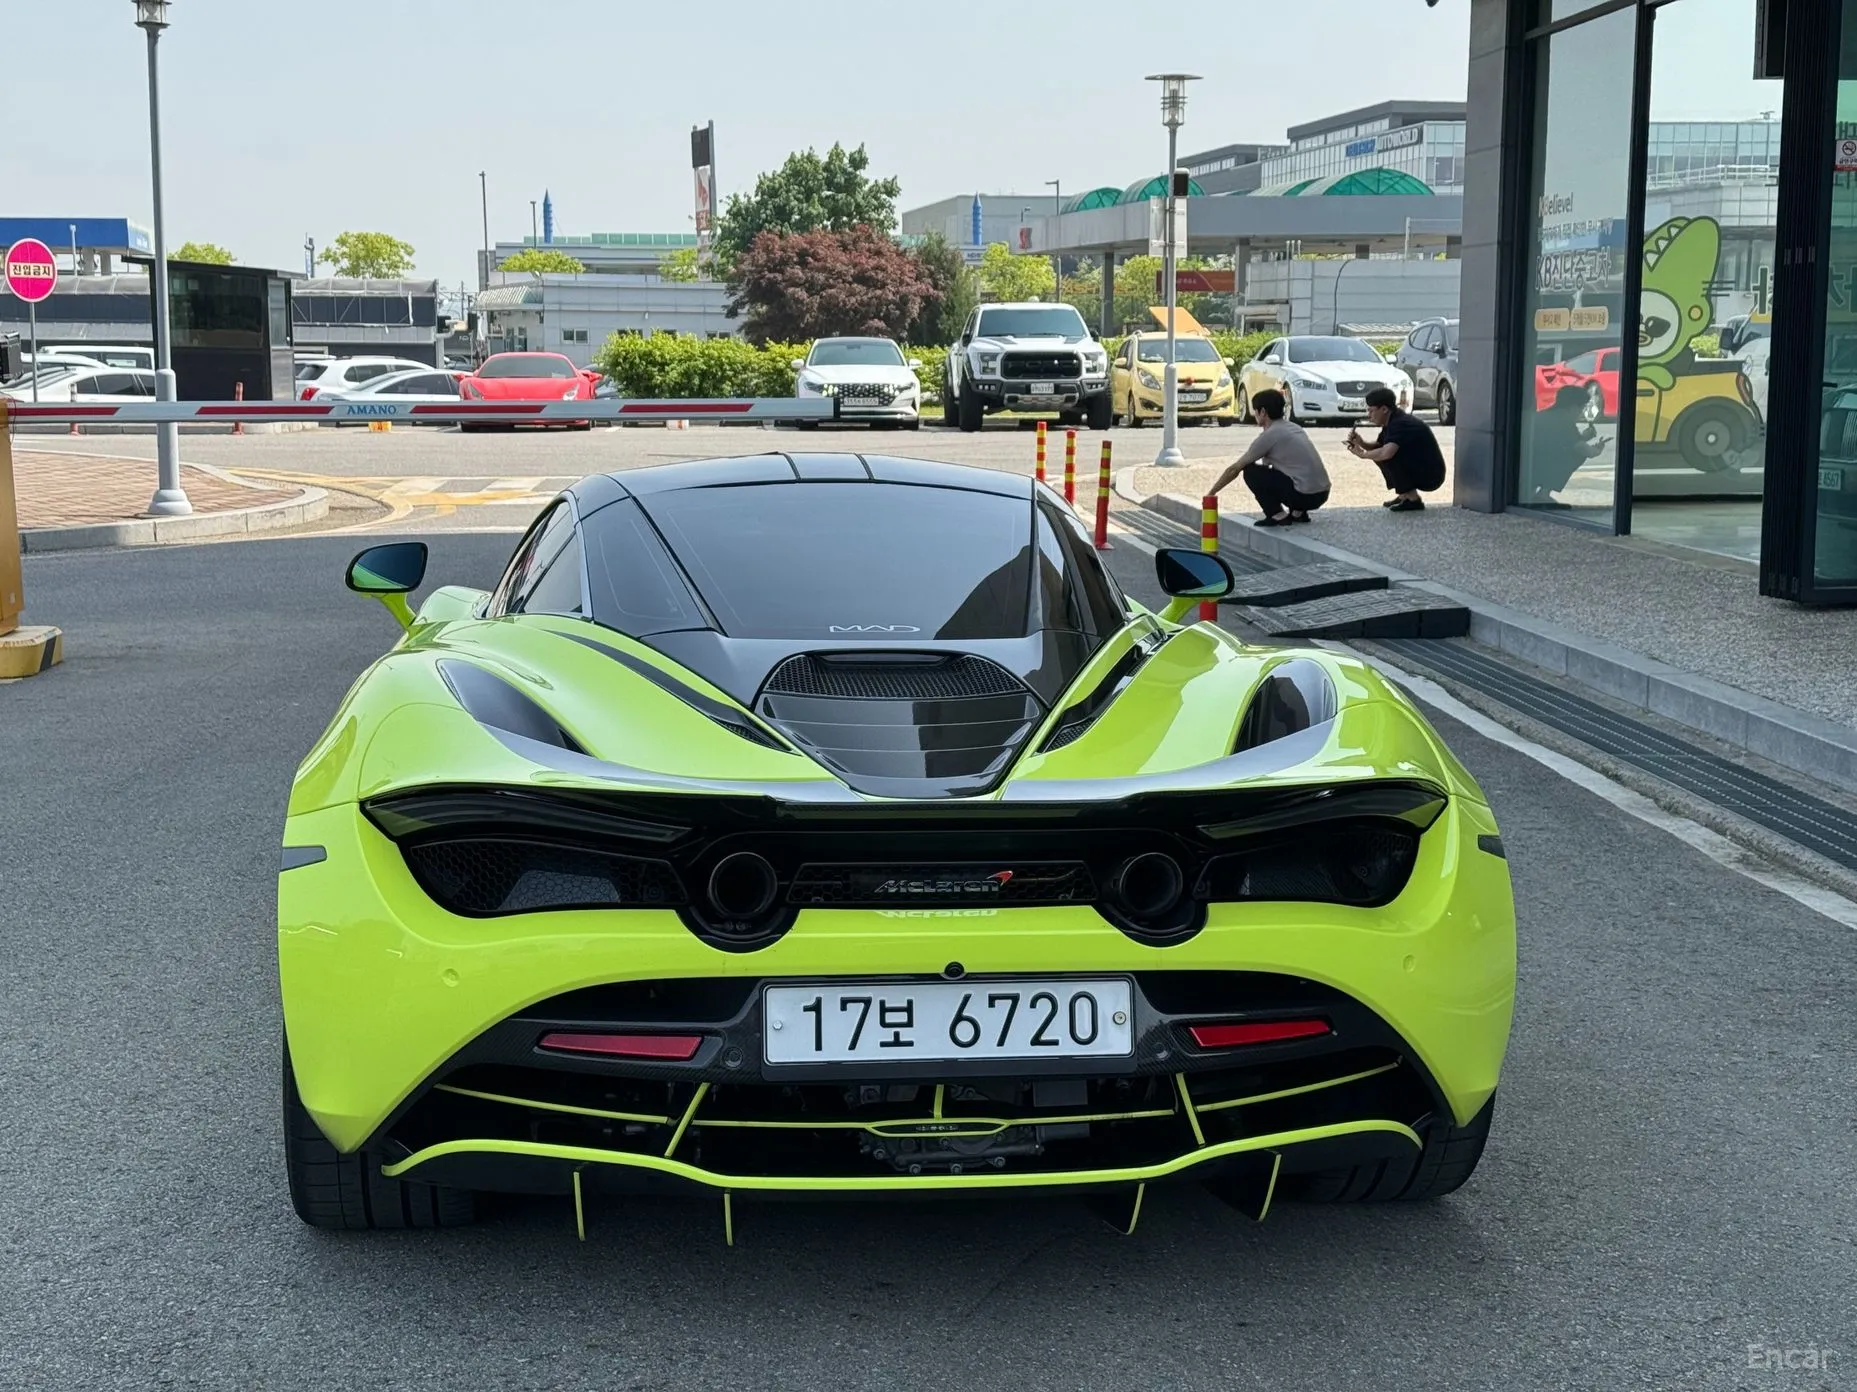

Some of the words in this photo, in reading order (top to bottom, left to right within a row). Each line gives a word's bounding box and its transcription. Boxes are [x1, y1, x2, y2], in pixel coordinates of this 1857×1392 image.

[12, 264, 51, 276] 진입금지
[347, 405, 397, 415] AMANO
[829, 625, 921, 633] MAD
[875, 879, 999, 893] McLaren
[803, 995, 914, 1052] 17보
[949, 991, 1098, 1049] 6720
